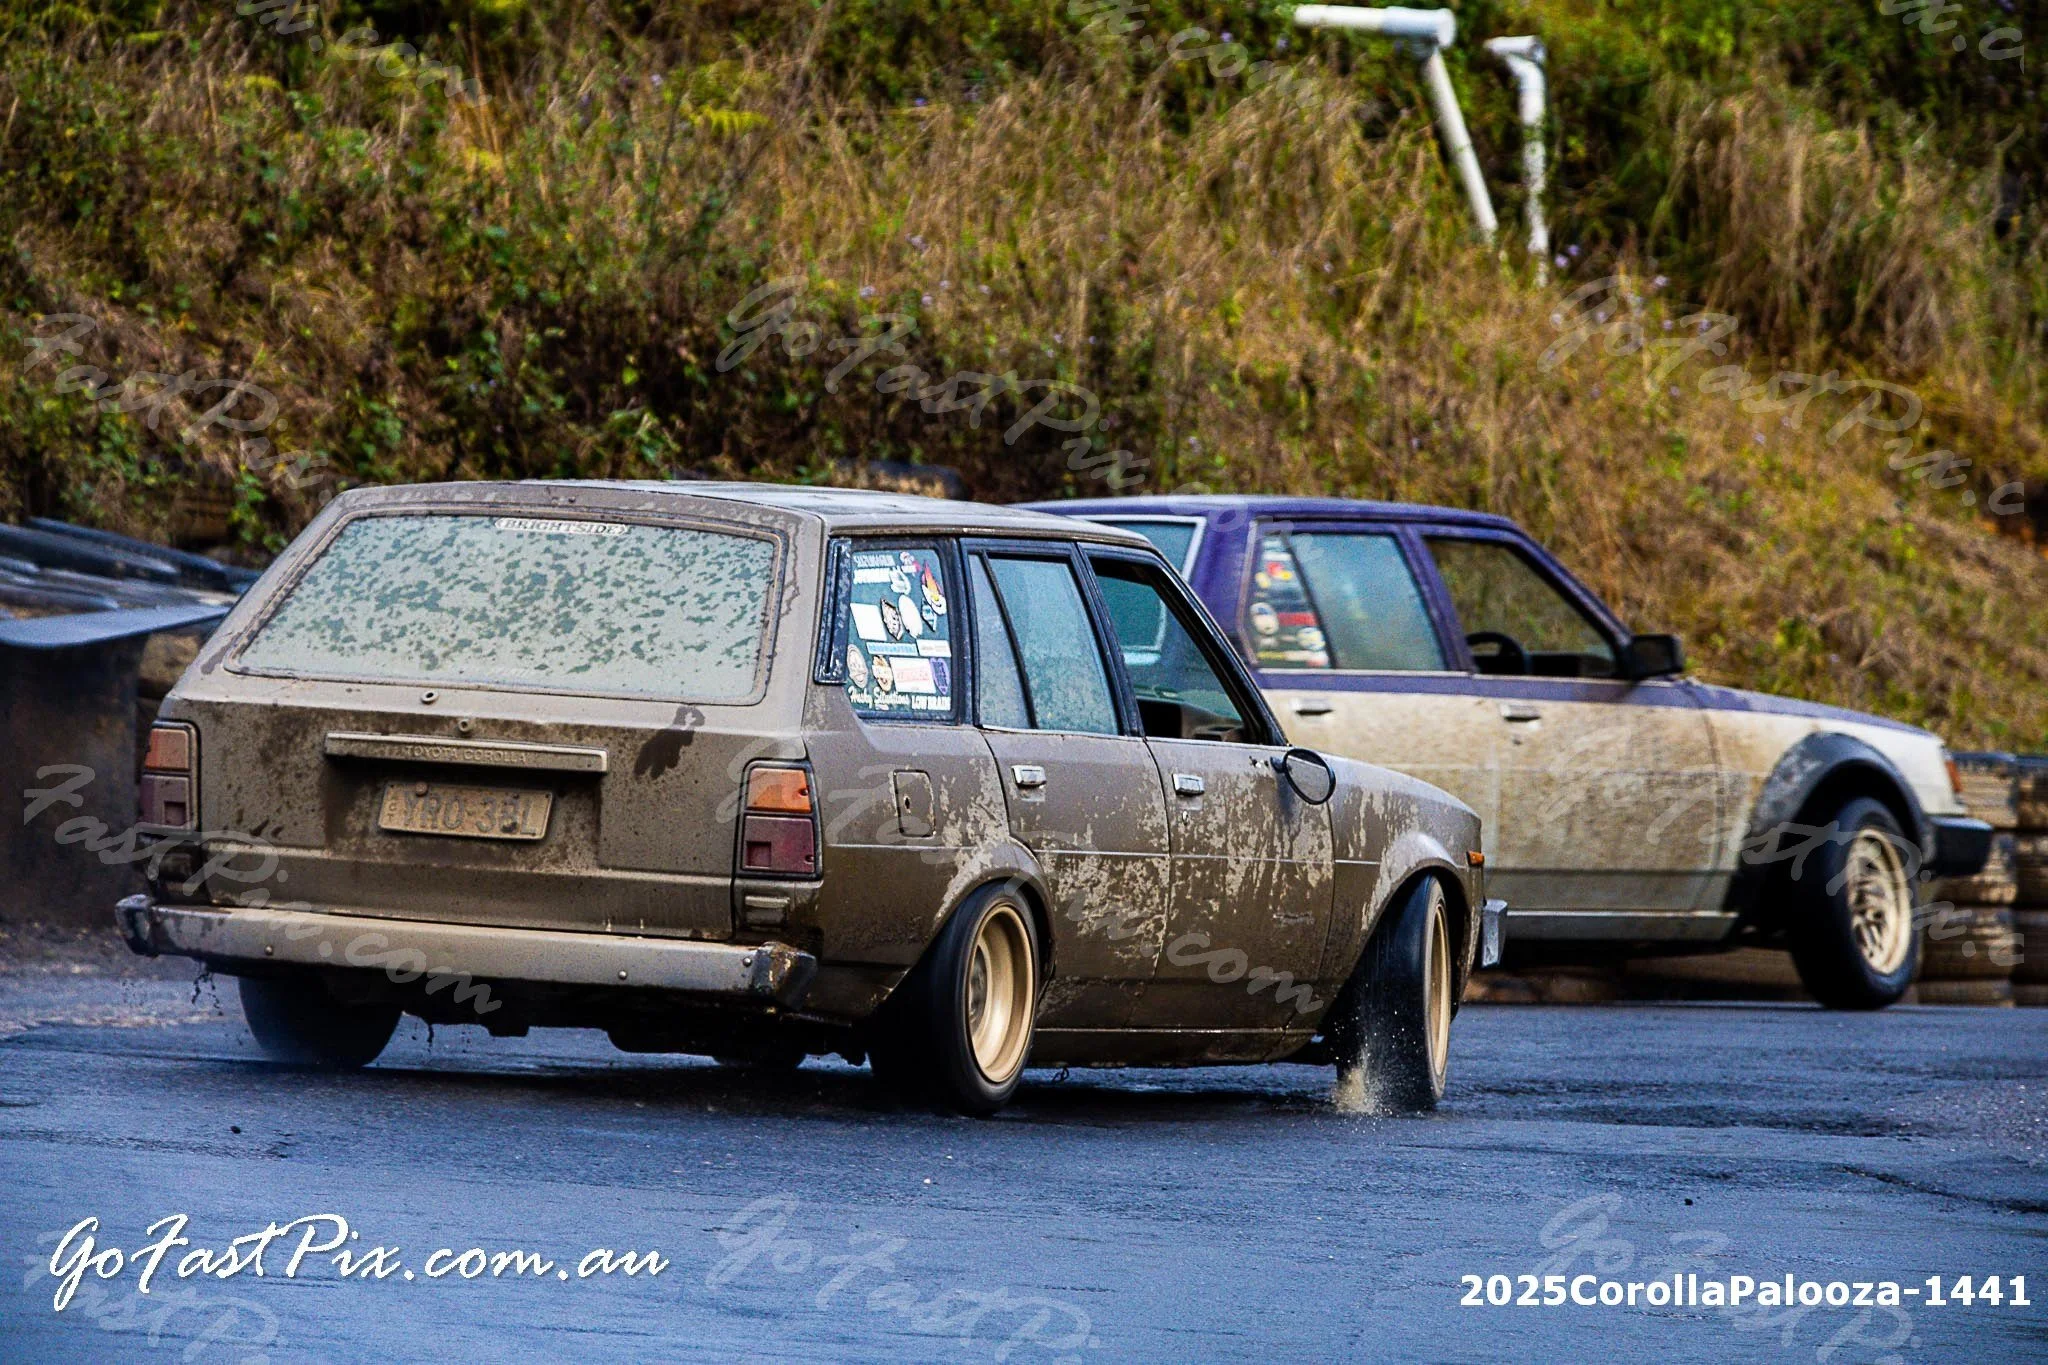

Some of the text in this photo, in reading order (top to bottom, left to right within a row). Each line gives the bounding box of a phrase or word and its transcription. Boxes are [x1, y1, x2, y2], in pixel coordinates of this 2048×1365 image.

[504, 518, 618, 534] BRIGHTSIDE
[405, 745, 526, 763] TOYOTA COROLLA
